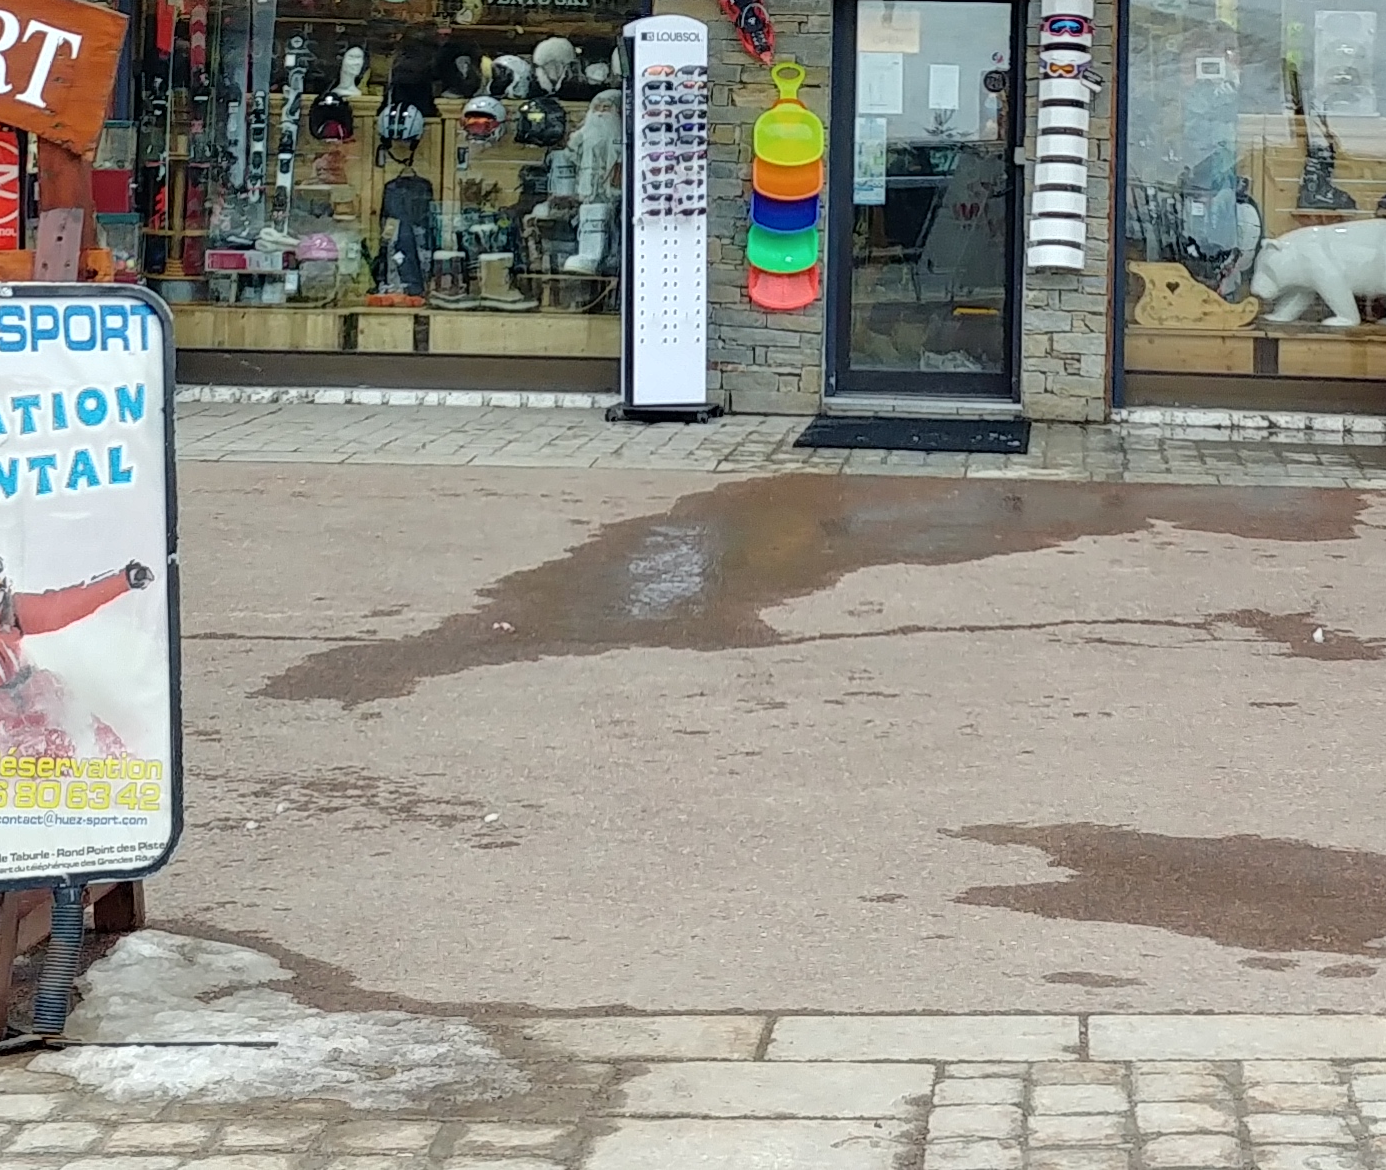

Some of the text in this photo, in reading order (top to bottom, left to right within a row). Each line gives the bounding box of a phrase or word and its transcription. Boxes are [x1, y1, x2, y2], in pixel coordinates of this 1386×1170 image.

[656, 32, 702, 43] LOUBSOL
[13, 781, 61, 809] 80
[64, 782, 111, 810] 63
[114, 782, 162, 811] 42
[9, 850, 48, 863] Taburle
[56, 846, 84, 858] Rond
[87, 844, 115, 856] Point
[117, 843, 136, 854] des
[138, 840, 167, 851] Piste
